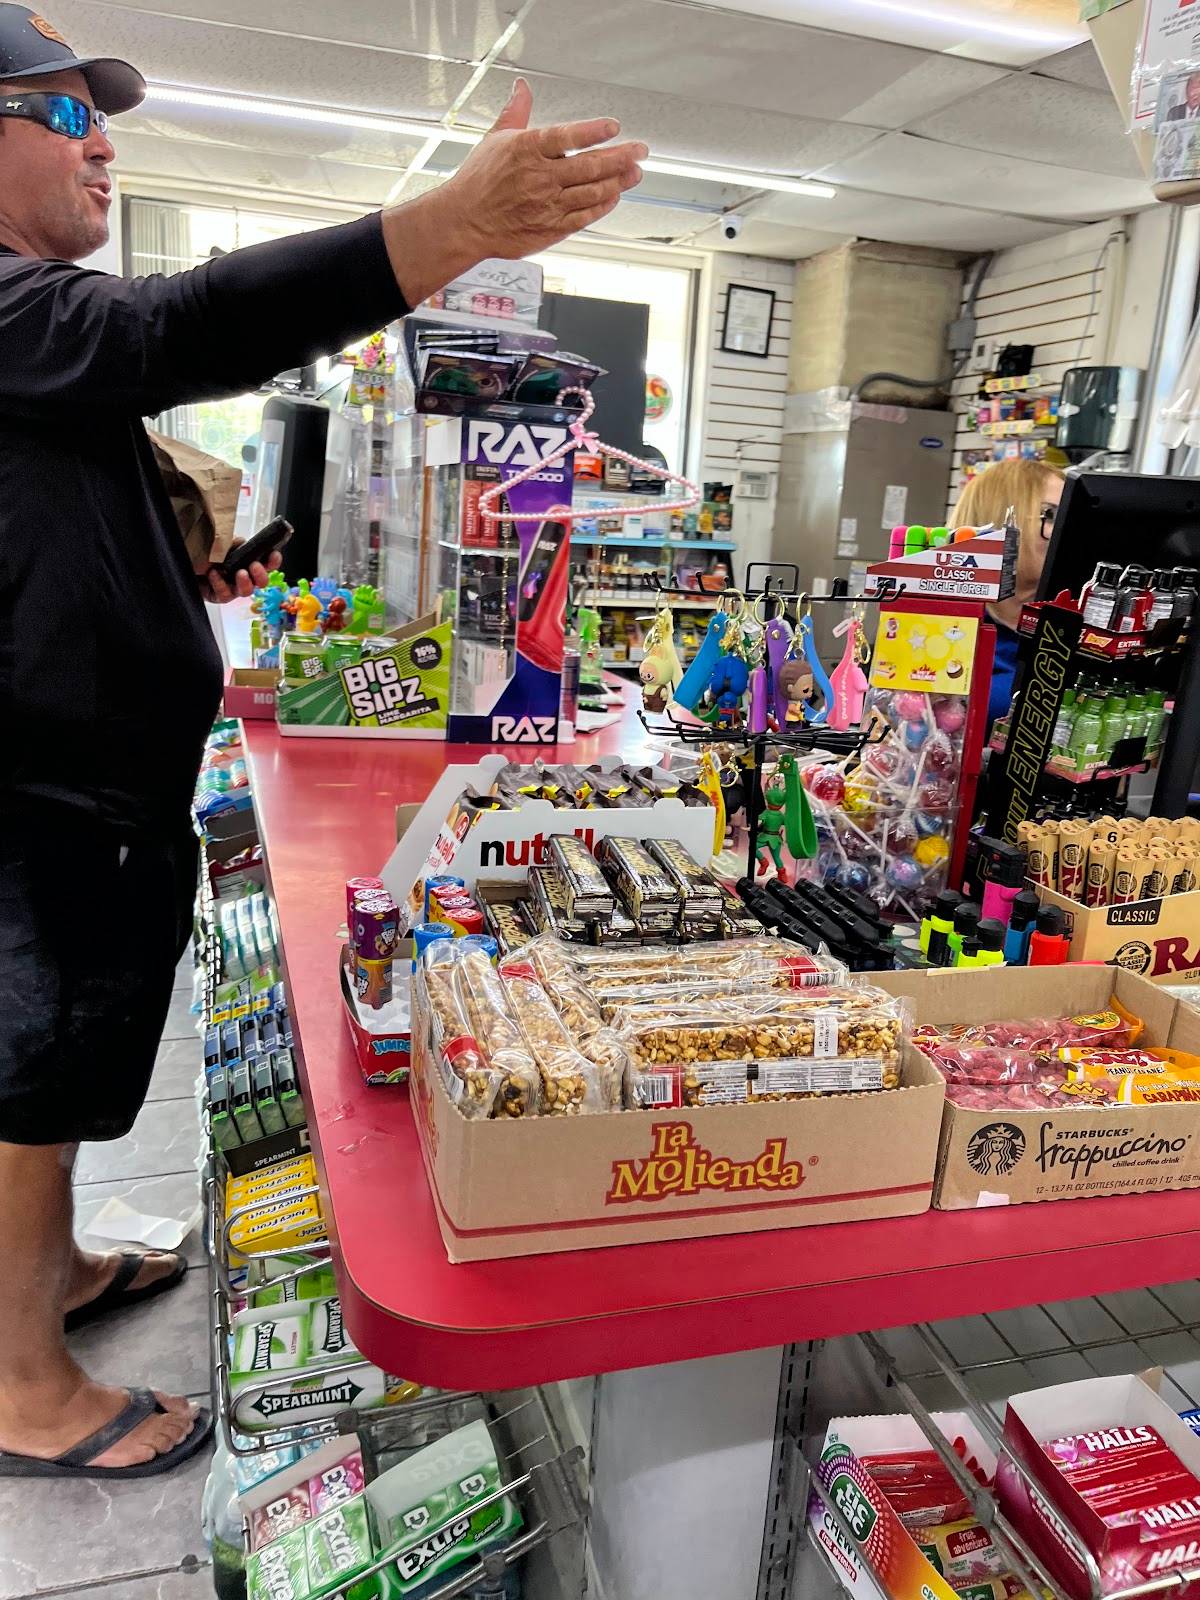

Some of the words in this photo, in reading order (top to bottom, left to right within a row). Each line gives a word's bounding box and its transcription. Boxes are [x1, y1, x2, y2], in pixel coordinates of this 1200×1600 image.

[467, 420, 567, 469] RAZ
[935, 552, 979, 568] USA
[933, 566, 976, 581] CLASSIC
[919, 578, 955, 594] SINGLE
[954, 582, 990, 596] TORCH
[379, 705, 432, 727] MARGARITA
[1006, 620, 1071, 796] ENERGY
[491, 716, 556, 743] RAZ
[1111, 908, 1156, 923] CLASSIC
[651, 1122, 692, 1159] La
[1055, 1128, 1129, 1141] STARBUCKS
[254, 1147, 297, 1168] SPEARMINT
[1035, 1121, 1187, 1180] frappuccino
[607, 1140, 803, 1201] Molienda
[1112, 1159, 1136, 1168] chilled
[1137, 1158, 1160, 1167] coffee
[1160, 1156, 1180, 1165] drink
[1036, 1186, 1044, 1194] 12
[1051, 1184, 1065, 1193] 13.7
[1085, 1181, 1114, 1190] BOTTLES
[327, 1300, 342, 1349] SPEARMINT
[261, 1383, 353, 1414] SPEARMINT
[835, 1487, 866, 1536] tac
[844, 1482, 871, 1523] tic
[952, 1535, 989, 1556] adventure
[958, 1529, 977, 1543] fruit
